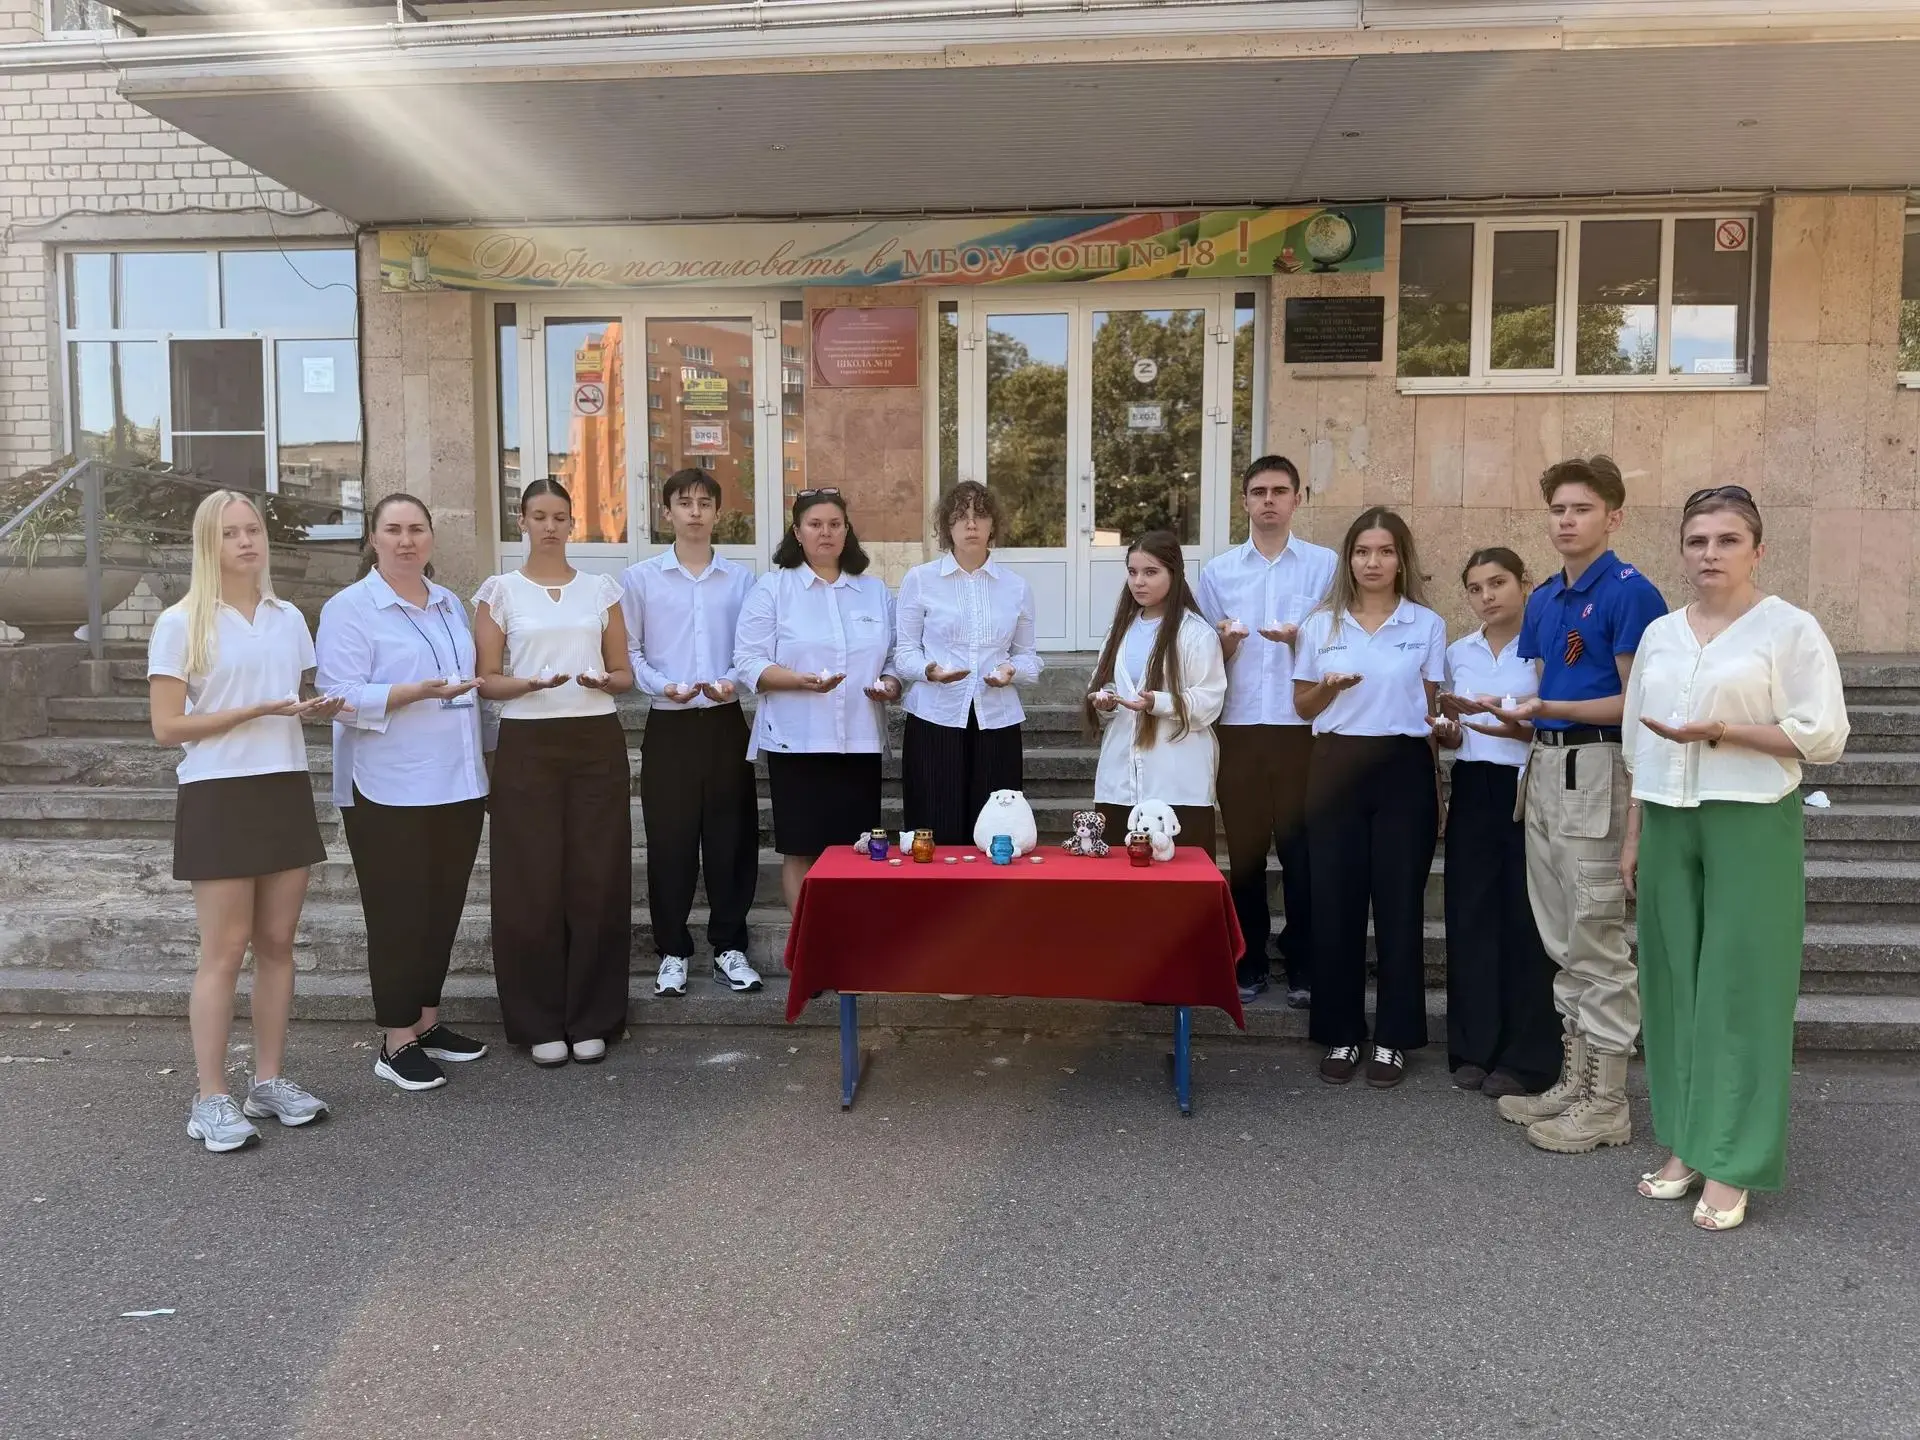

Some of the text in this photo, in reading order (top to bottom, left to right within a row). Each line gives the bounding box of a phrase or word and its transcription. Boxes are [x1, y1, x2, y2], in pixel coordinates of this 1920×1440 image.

[472, 233, 610, 288] Добро
[623, 239, 852, 278] пожаловать
[862, 237, 900, 276] в
[902, 248, 1016, 276] МБОУ
[1026, 244, 1121, 272] СОШ
[1131, 242, 1167, 269] №
[1178, 239, 1216, 266] 18
[836, 359, 872, 367] ШКОЛА
[694, 431, 719, 439] ВХОД
